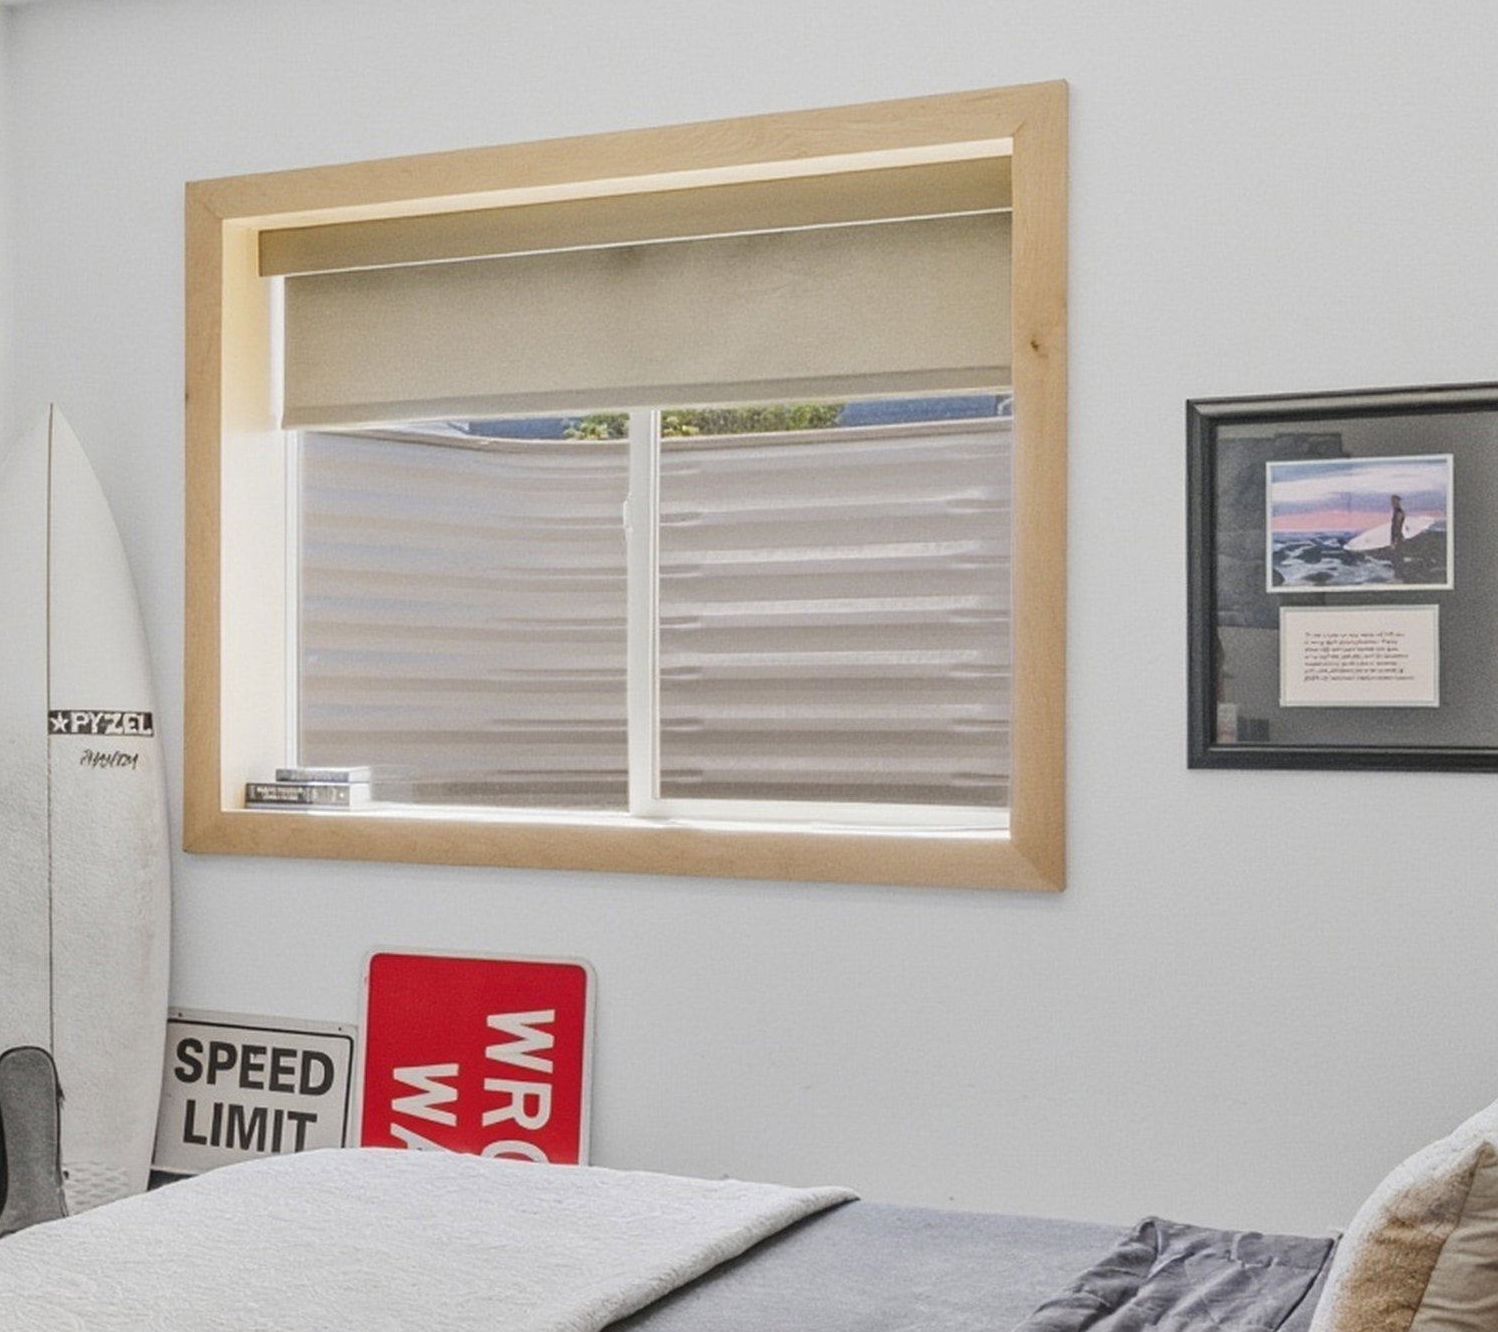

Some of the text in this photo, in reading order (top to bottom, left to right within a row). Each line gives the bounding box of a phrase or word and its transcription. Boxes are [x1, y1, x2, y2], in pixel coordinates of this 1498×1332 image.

[70, 711, 154, 736] PYZEL
[174, 1037, 335, 1096] SPEED
[182, 1099, 318, 1154] LIMIT
